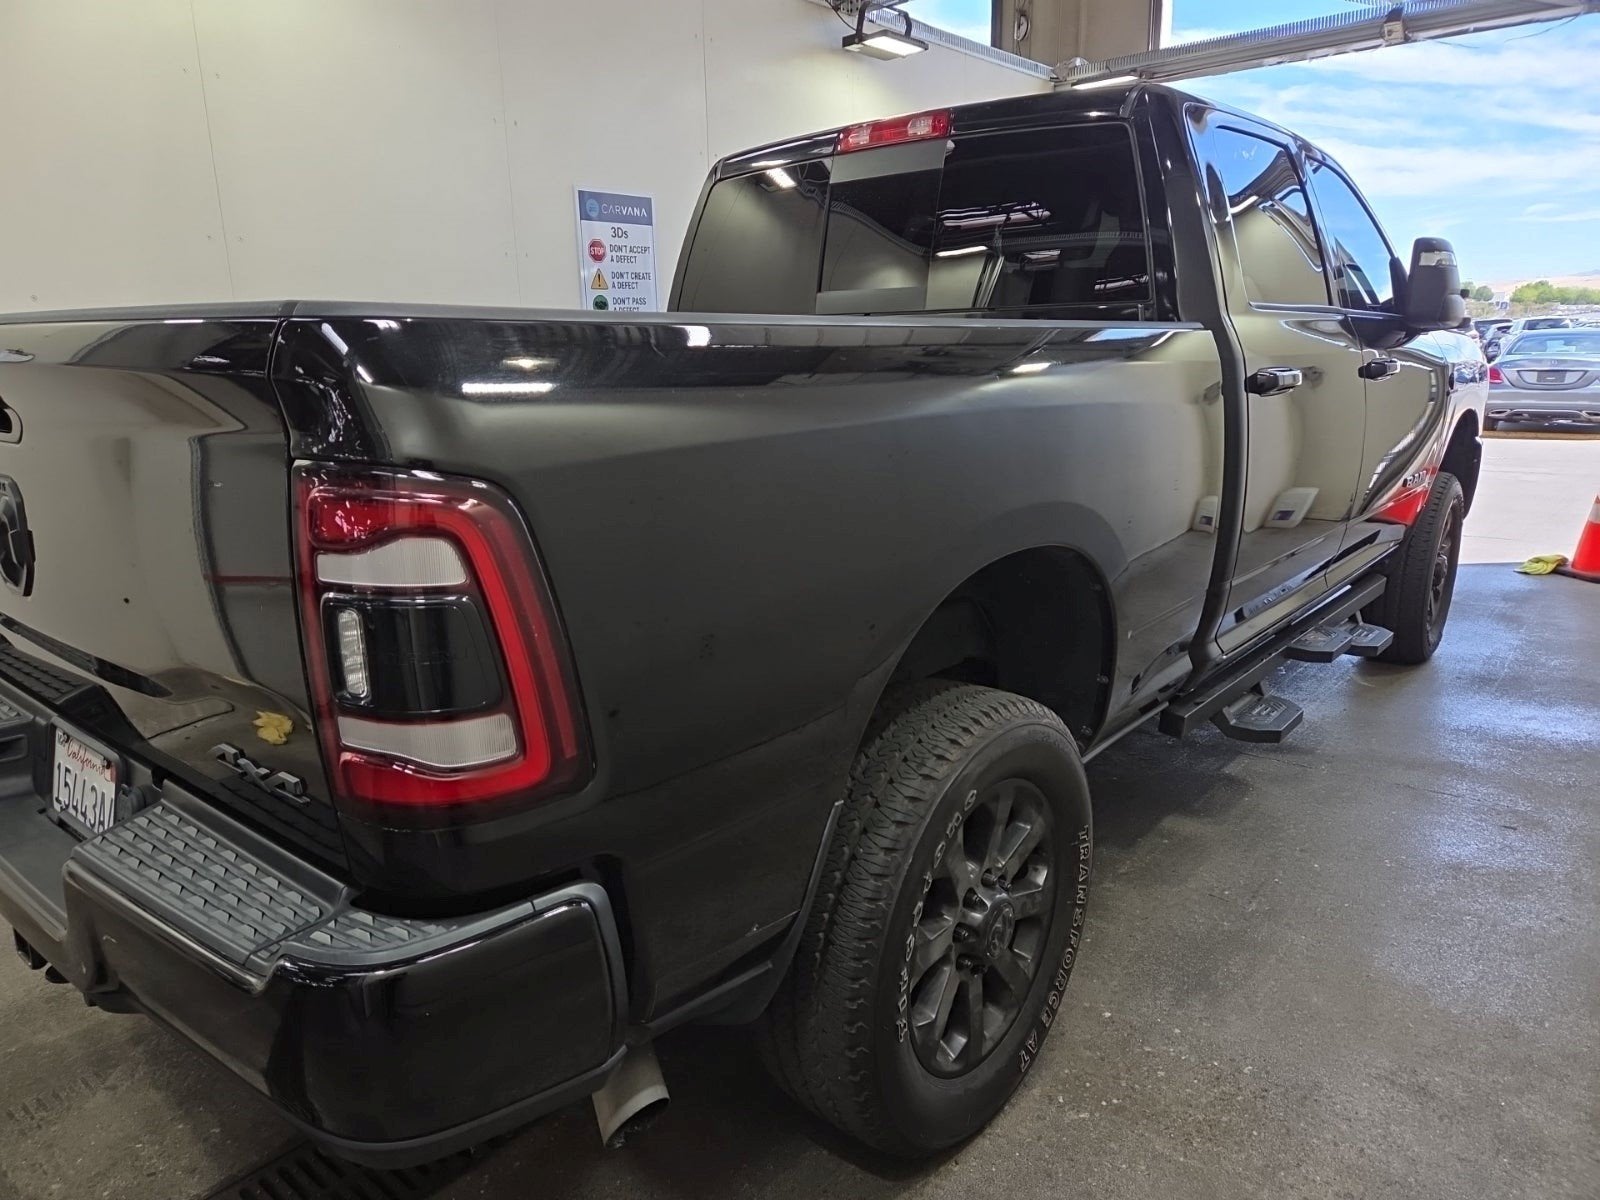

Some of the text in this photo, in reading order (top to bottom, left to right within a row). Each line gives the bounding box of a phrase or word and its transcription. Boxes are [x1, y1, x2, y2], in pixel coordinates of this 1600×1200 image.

[601, 203, 648, 218] CARVANA
[610, 226, 629, 239] 3Ds
[590, 246, 605, 256] STOP
[609, 244, 651, 255] DON'T ACCEPT
[615, 256, 637, 264] DEFECT
[611, 271, 652, 281] DON'T CREATE
[617, 281, 639, 290] DEFECT
[612, 296, 647, 306] DON'T PASS
[1018, 1030, 1039, 1073] AT
